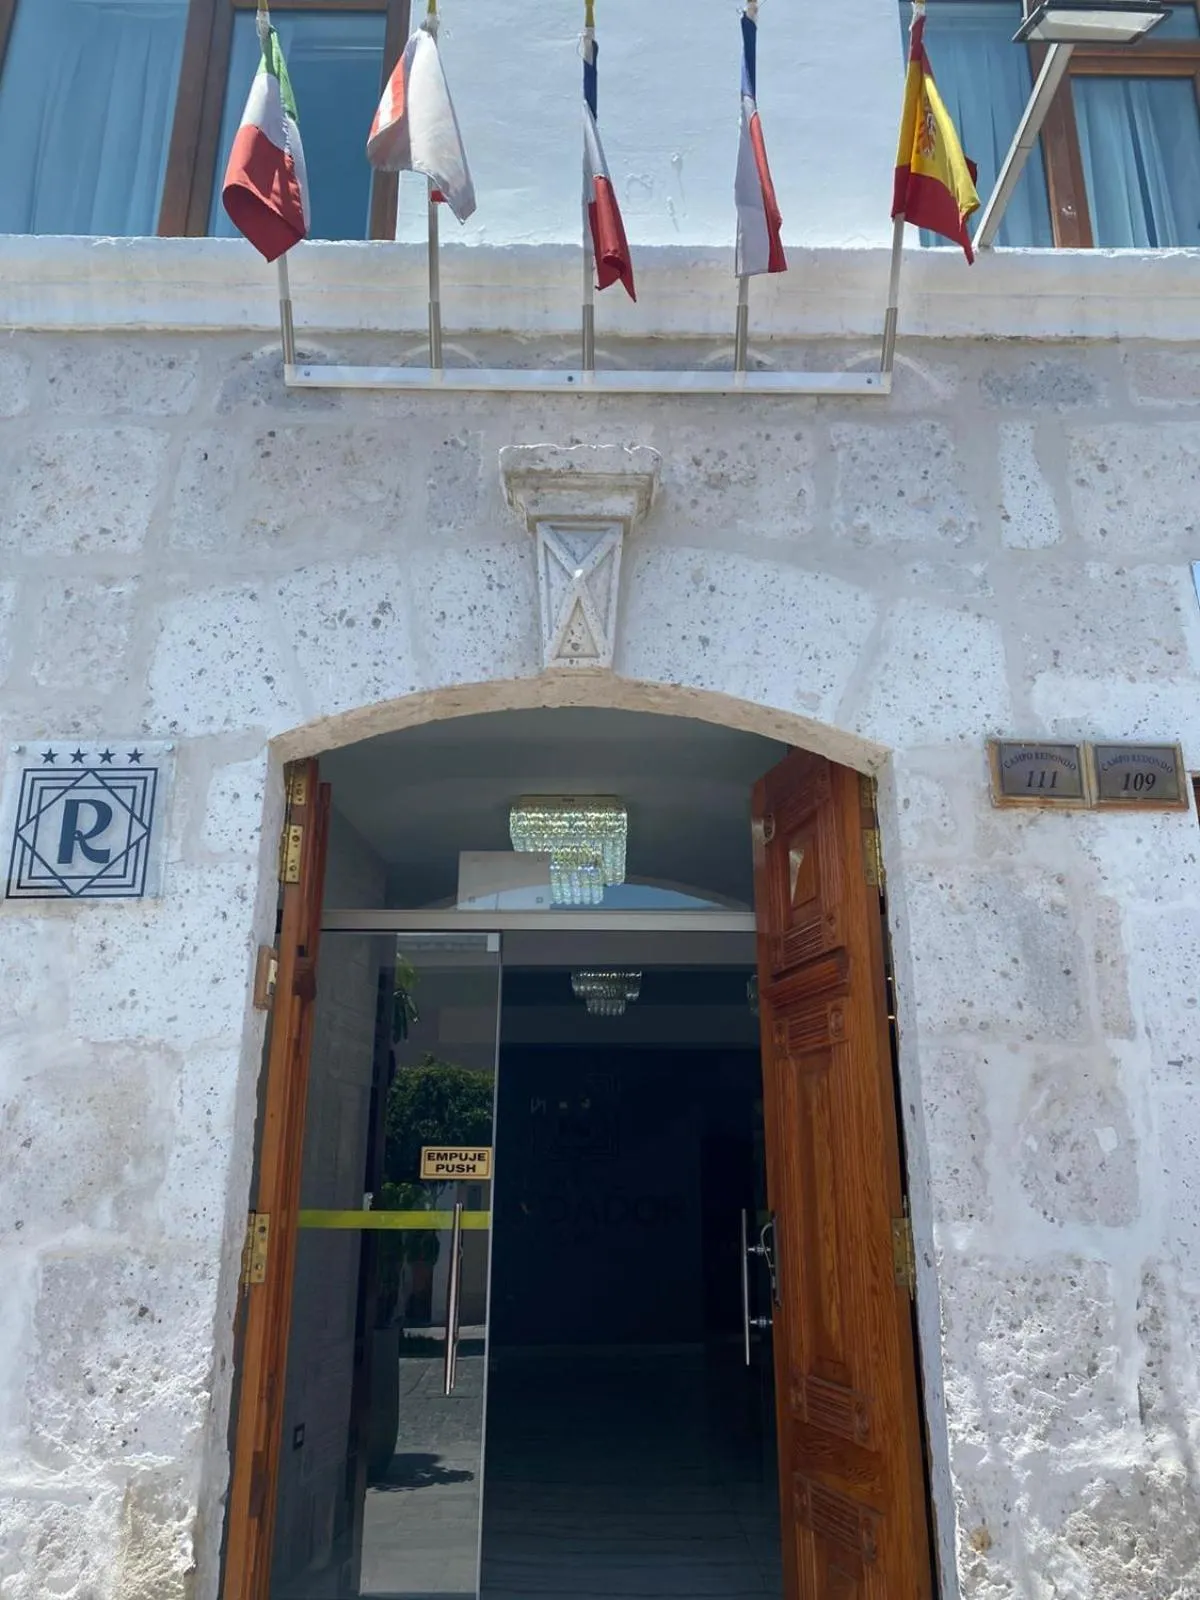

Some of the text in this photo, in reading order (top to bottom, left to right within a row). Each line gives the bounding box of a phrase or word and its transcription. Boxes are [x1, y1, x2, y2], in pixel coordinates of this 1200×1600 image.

[1003, 751, 1077, 770] CAMPO REDONDO
[1026, 770, 1058, 789] 111
[1122, 772, 1156, 792] 109
[57, 798, 113, 865] R
[427, 1152, 487, 1162] EMPUJE
[435, 1163, 477, 1173] PUSH
